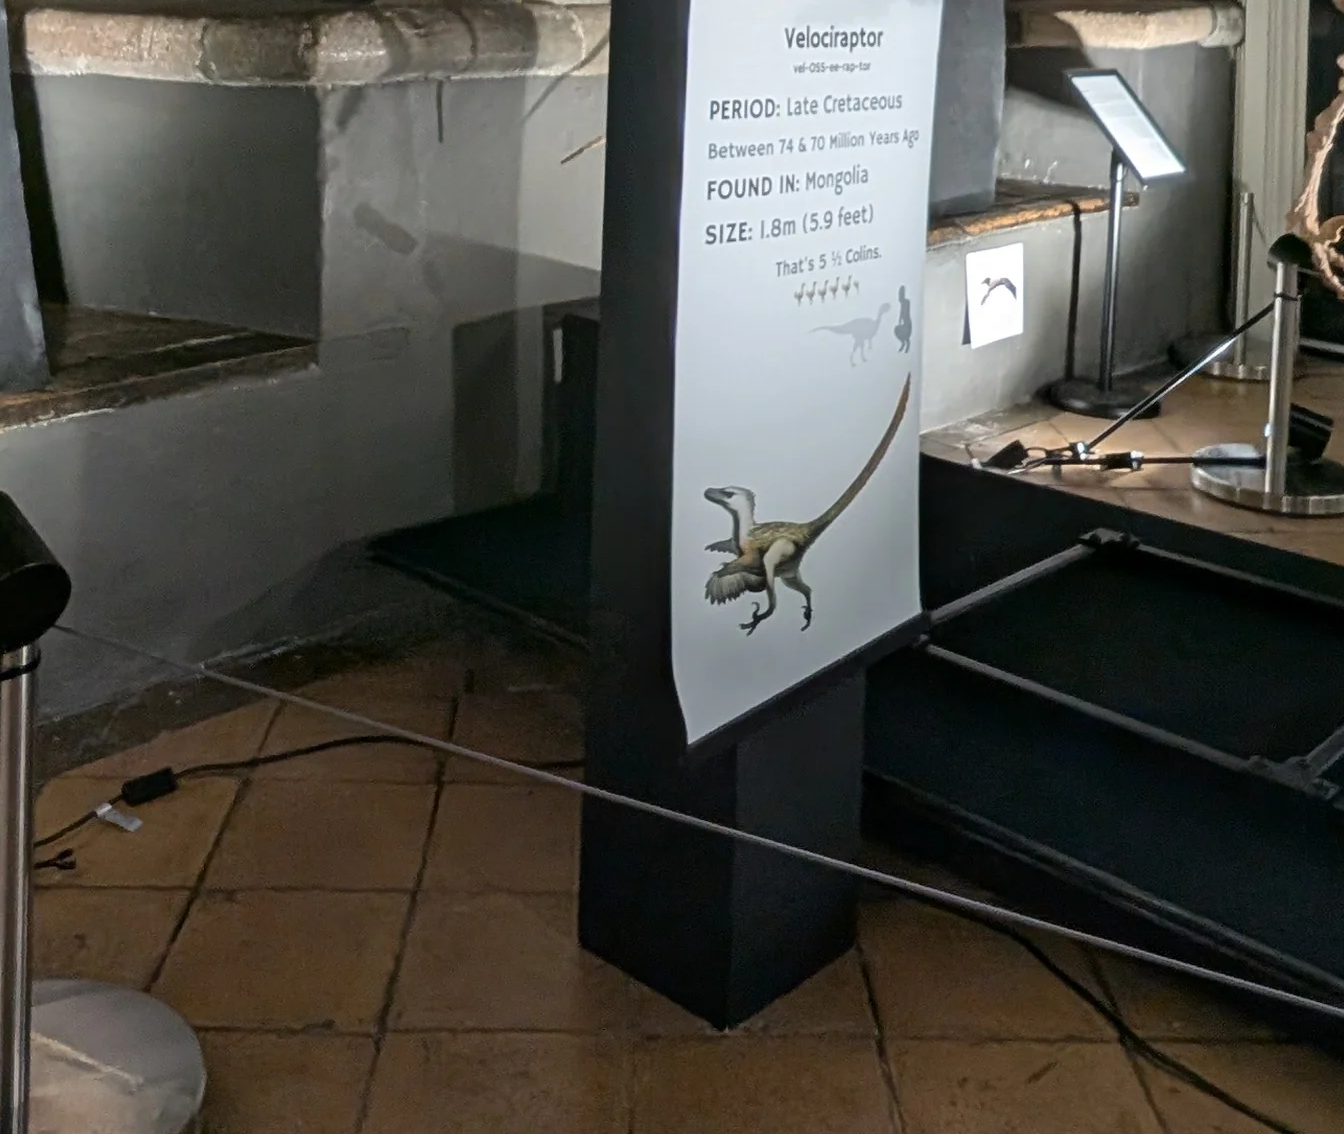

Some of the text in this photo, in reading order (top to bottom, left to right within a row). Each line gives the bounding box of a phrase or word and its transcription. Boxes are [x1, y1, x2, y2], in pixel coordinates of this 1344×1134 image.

[784, 24, 884, 53] Velociraptor
[709, 94, 903, 120] PERIOD: Late Cretaceous
[708, 128, 920, 159] Between 74 & 70 Million Years Ago
[707, 163, 869, 201] FOUND IN: Mongolia
[705, 204, 874, 245] SIZE: 1.8m (5.9 feet)
[775, 256, 814, 277] That's
[819, 253, 827, 270] 5
[845, 244, 882, 265] Colins.
